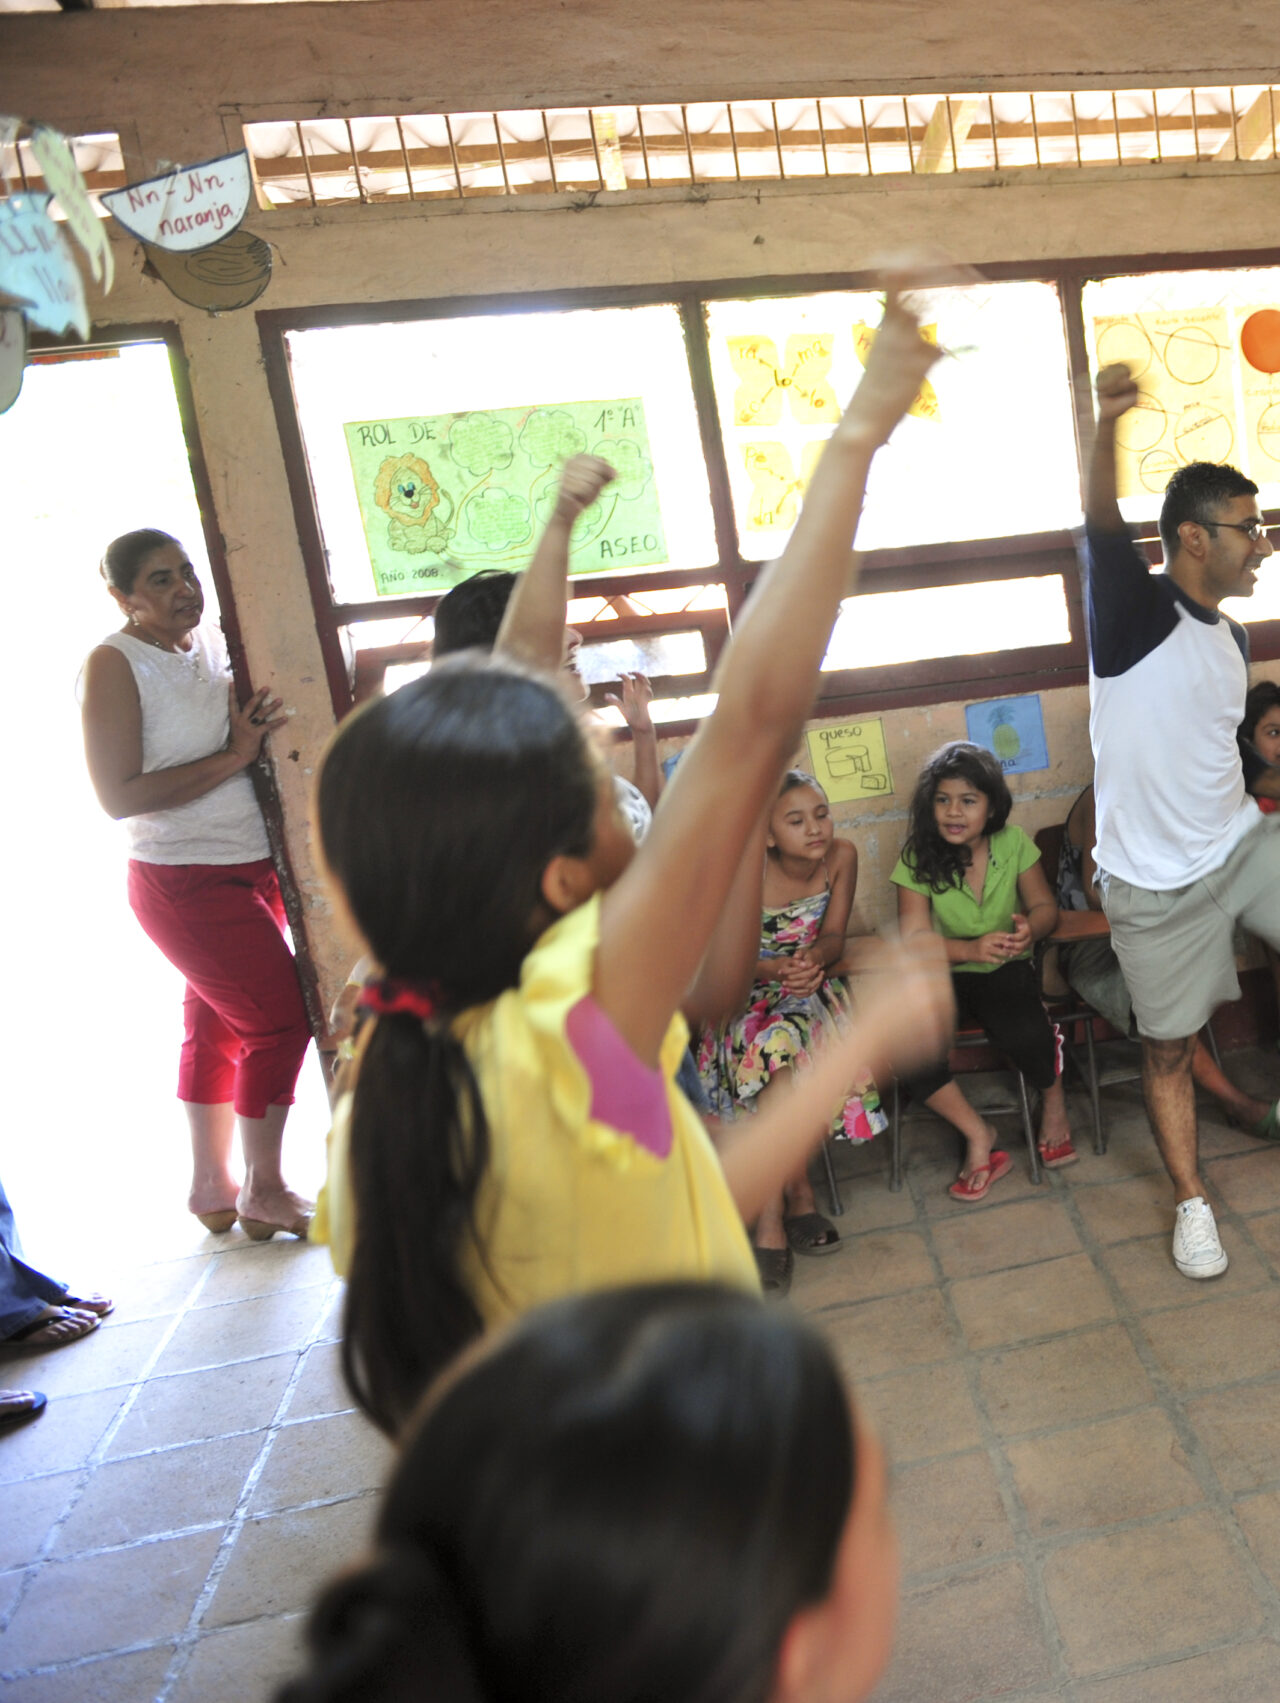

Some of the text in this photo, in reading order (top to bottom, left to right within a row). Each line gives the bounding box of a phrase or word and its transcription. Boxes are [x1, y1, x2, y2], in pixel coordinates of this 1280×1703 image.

[158, 203, 235, 239] naranja
[356, 423, 397, 447] ROL
[407, 420, 437, 445] DE
[380, 568, 406, 584] AÑO
[819, 725, 862, 748] queso
